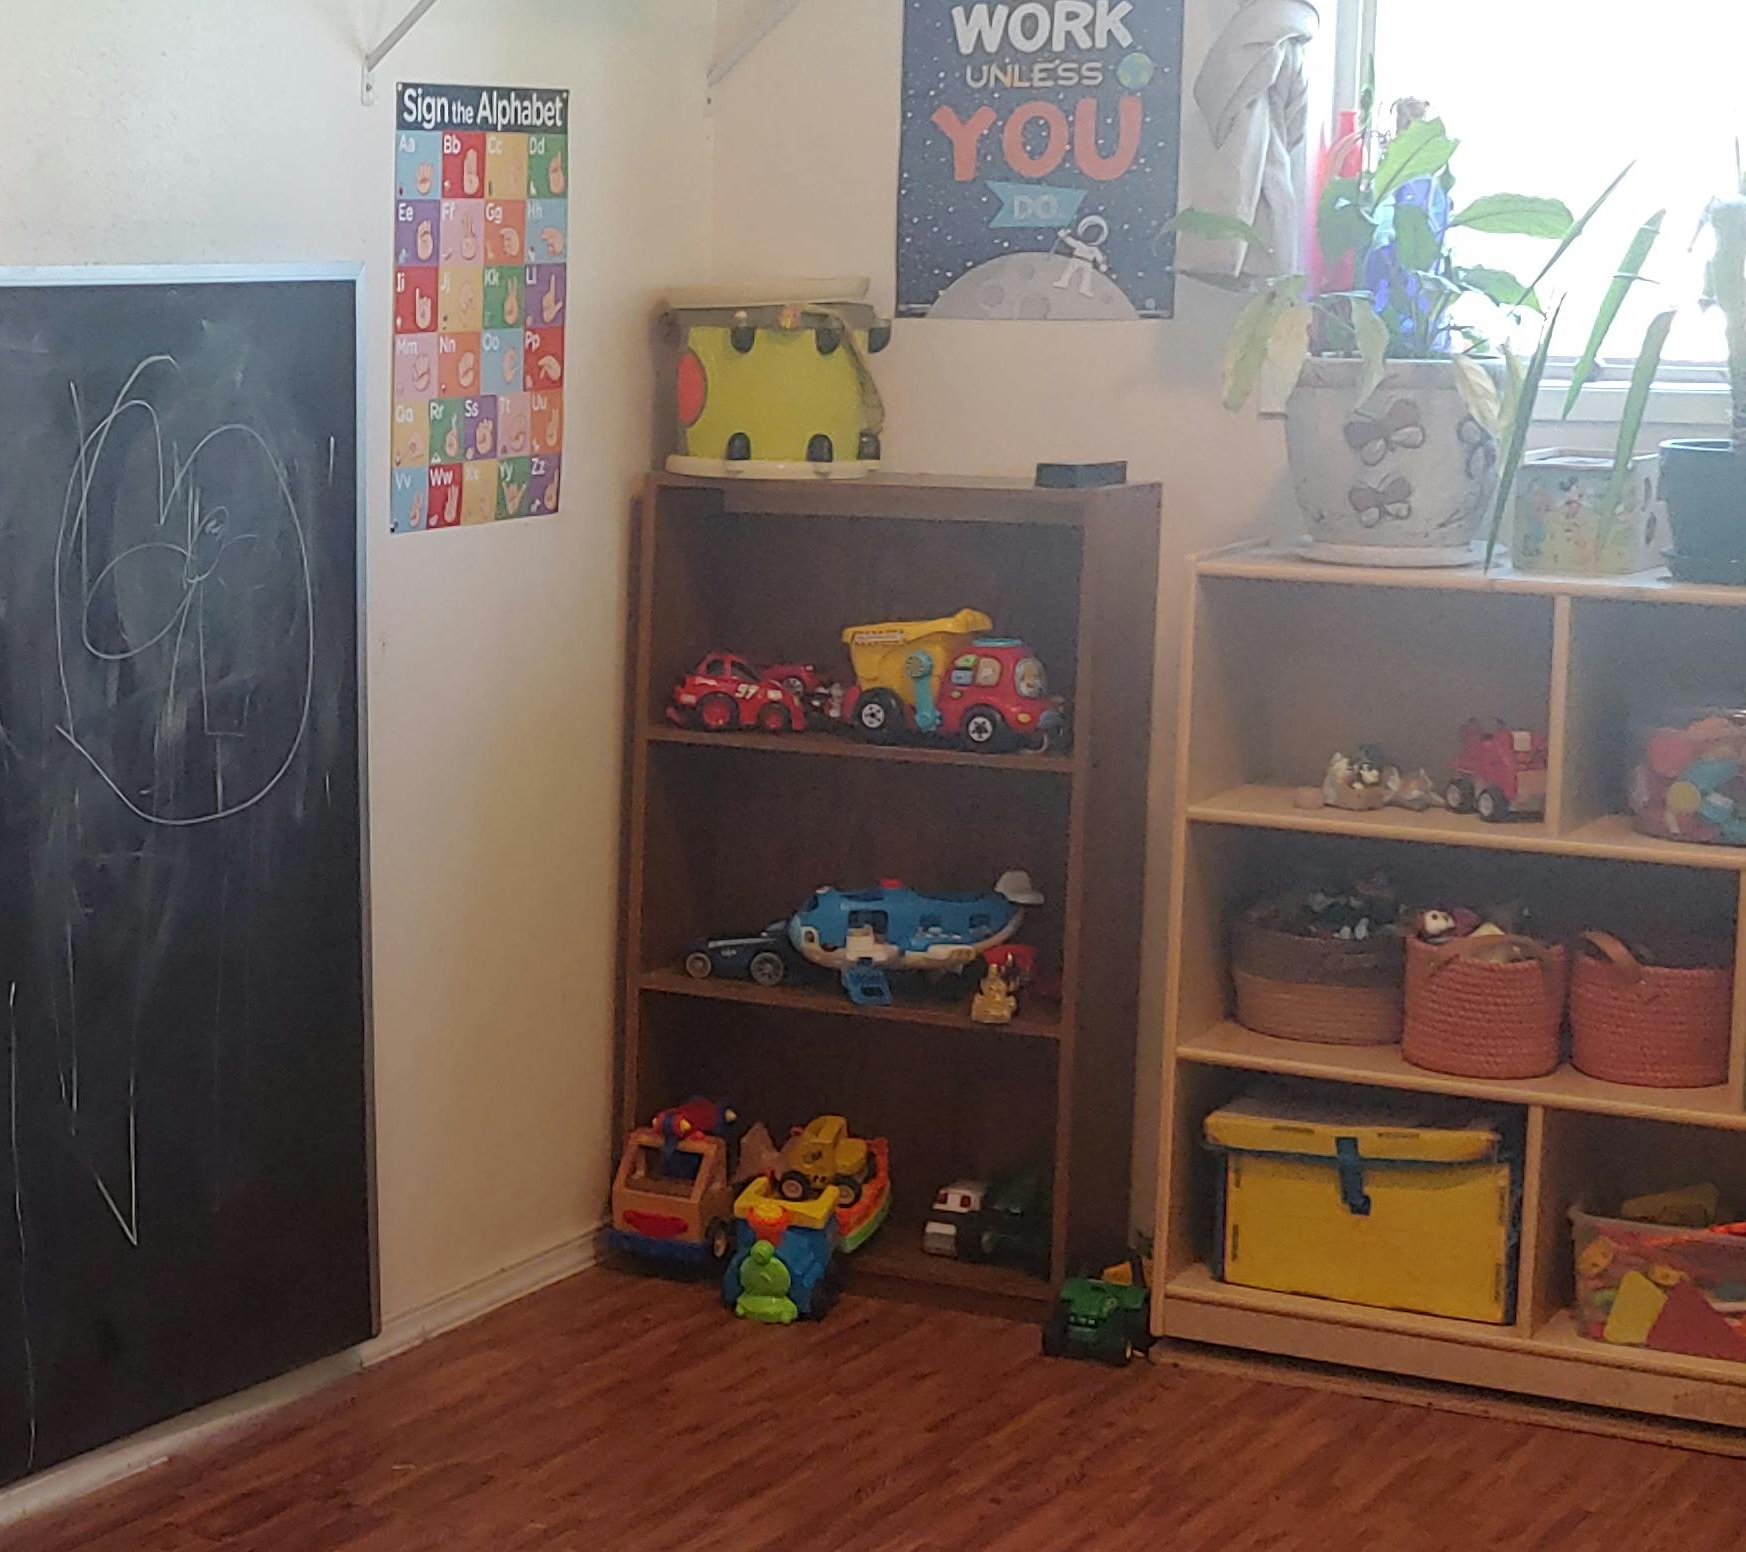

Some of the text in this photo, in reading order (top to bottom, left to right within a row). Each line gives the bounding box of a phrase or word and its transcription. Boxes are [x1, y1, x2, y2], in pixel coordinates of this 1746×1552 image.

[951, 0, 1134, 55] WORK
[965, 60, 1104, 88] UNLESS
[403, 87, 563, 131] Sign the Alphabet
[443, 135, 461, 154] Bb
[529, 136, 545, 155] Dd
[930, 95, 1143, 182] YOU
[398, 203, 503, 224] Ee Gg
[439, 330, 541, 353] Nn Oo Pp
[430, 402, 444, 420] Rr
[464, 399, 479, 417] Ss
[429, 458, 546, 486] Ww Zz
